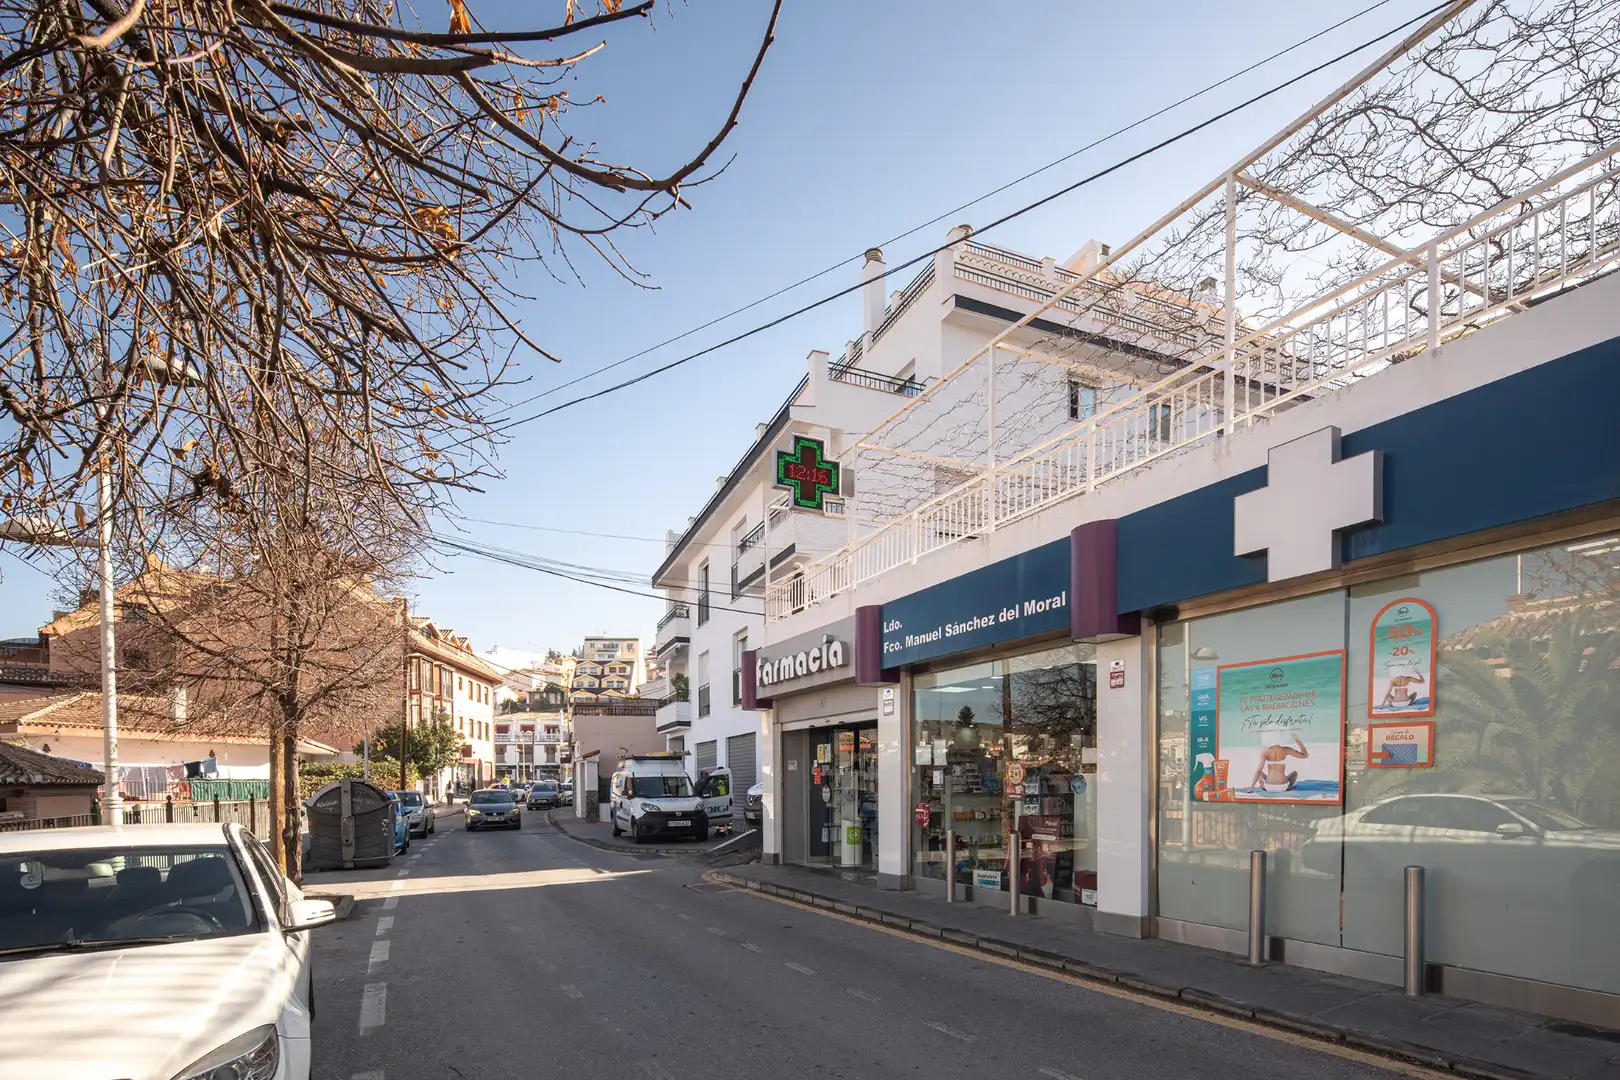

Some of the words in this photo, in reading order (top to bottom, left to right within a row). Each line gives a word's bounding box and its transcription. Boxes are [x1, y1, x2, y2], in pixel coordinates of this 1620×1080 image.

[883, 640, 903, 654] Fco.
[905, 626, 943, 649] Manuel
[945, 614, 995, 636] Sánchez
[998, 603, 1020, 623] del
[1023, 591, 1067, 617] Moral
[883, 620, 903, 634] Ldo.
[1249, 691, 1304, 703] PROTEGEMOS
[1305, 690, 1317, 698] DE
[1240, 704, 1255, 713] LAS
[1262, 700, 1316, 711] RADIACIONES
